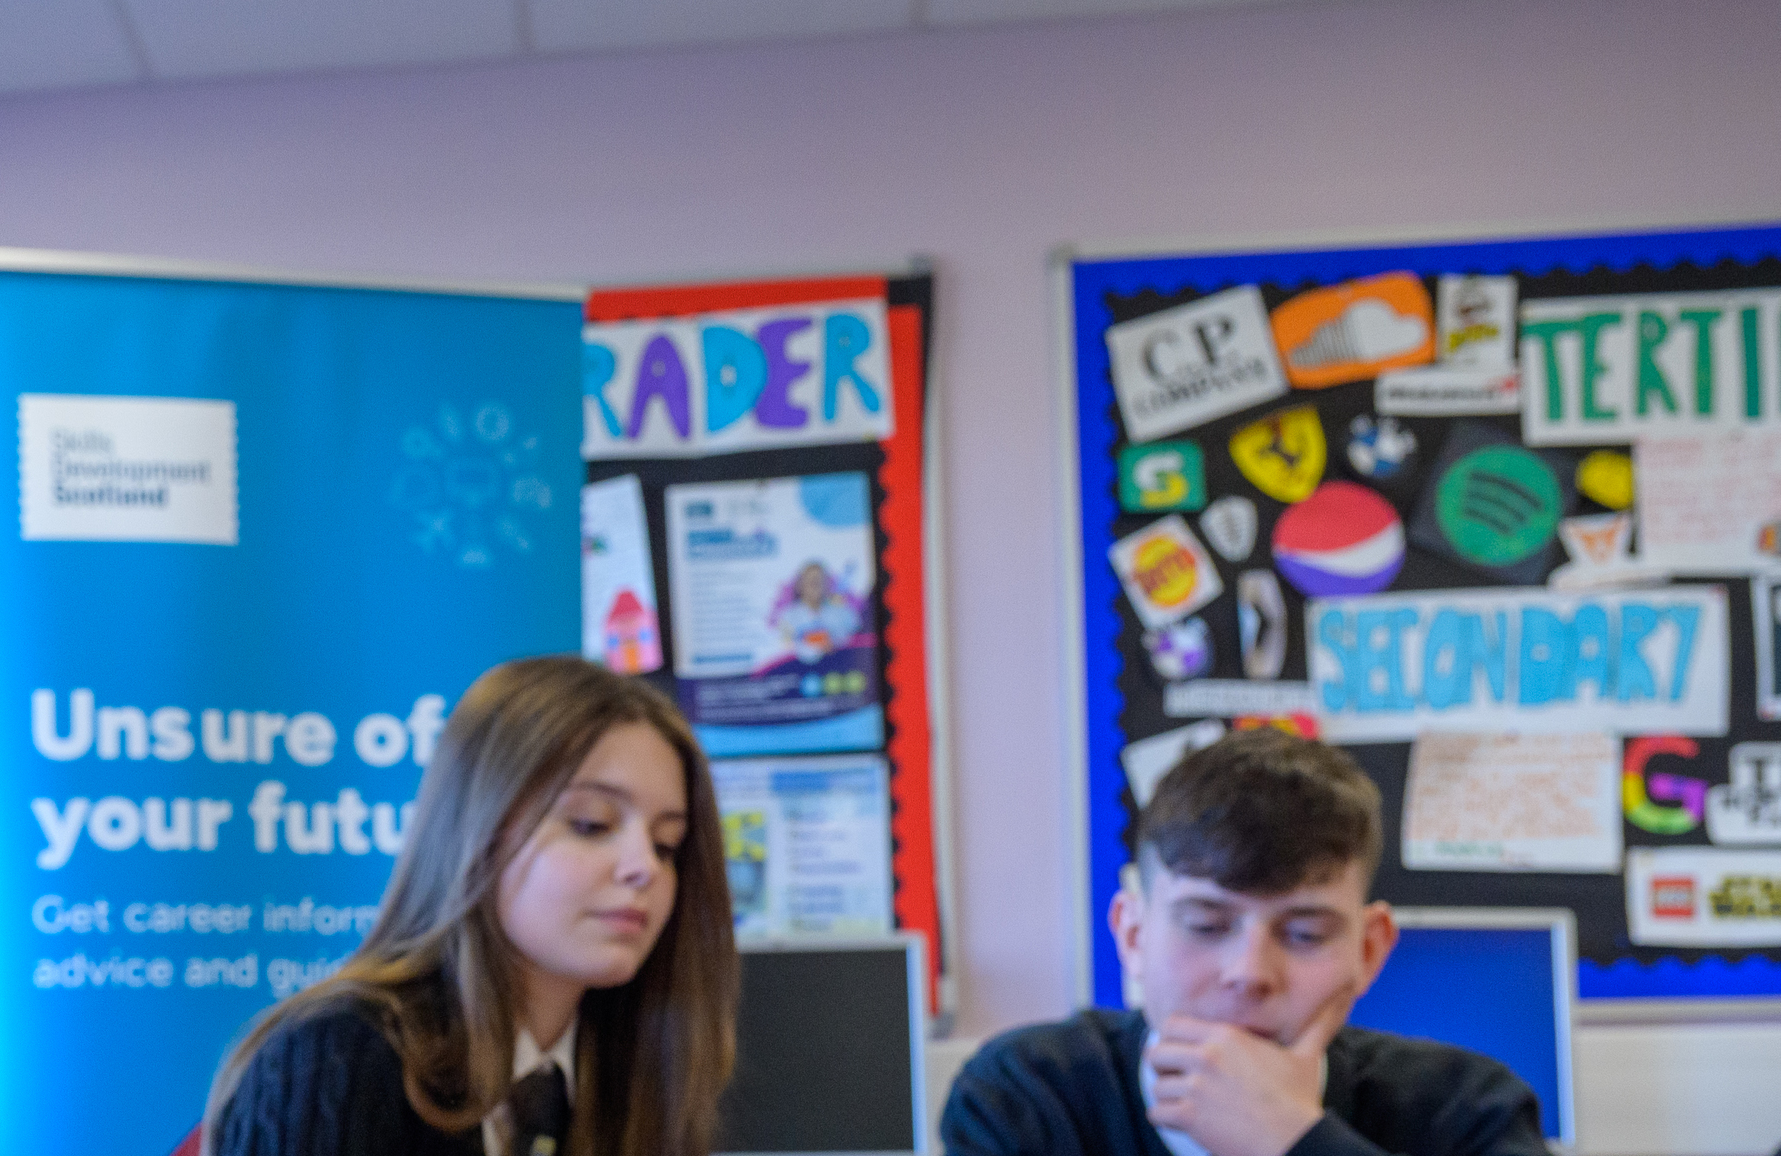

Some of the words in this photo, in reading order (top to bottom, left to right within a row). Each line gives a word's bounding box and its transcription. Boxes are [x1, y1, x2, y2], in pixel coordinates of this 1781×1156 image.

[1523, 308, 1781, 421] TERTI
[1319, 604, 1702, 714] SECONDARY
[354, 693, 446, 768] of
[30, 796, 233, 870] your
[248, 780, 418, 855] futu
[31, 895, 110, 934] Get
[123, 902, 252, 934] career
[32, 952, 174, 989] advice
[184, 953, 259, 989] and
